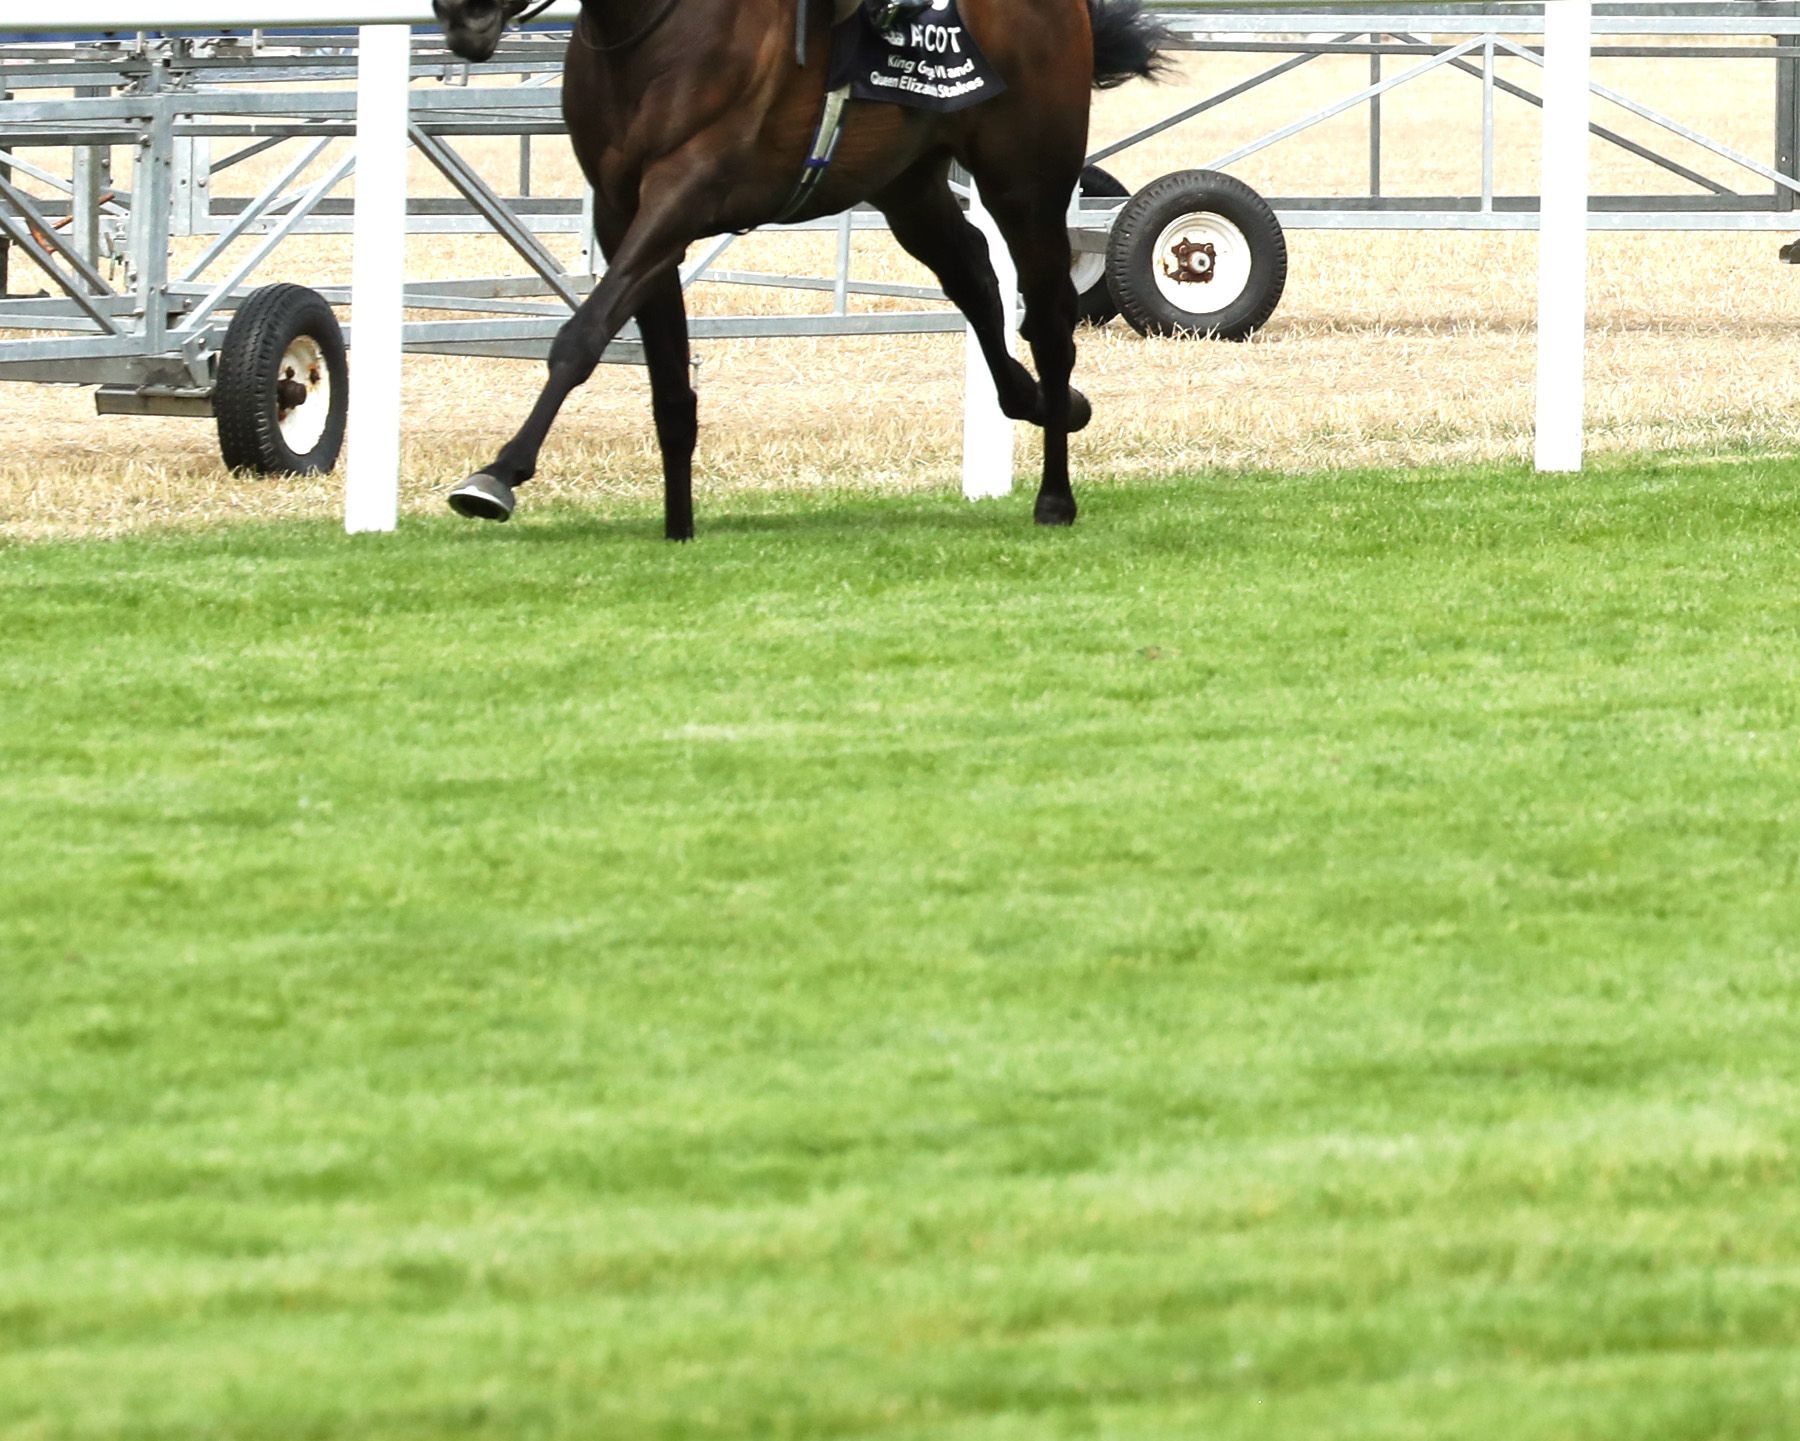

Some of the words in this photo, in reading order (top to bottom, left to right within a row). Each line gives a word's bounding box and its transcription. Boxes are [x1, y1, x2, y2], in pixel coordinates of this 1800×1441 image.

[910, 23, 962, 54] ACOT
[887, 53, 916, 74] King
[946, 57, 976, 79] and
[869, 71, 899, 89] Queen
[937, 76, 985, 99] Stakes
